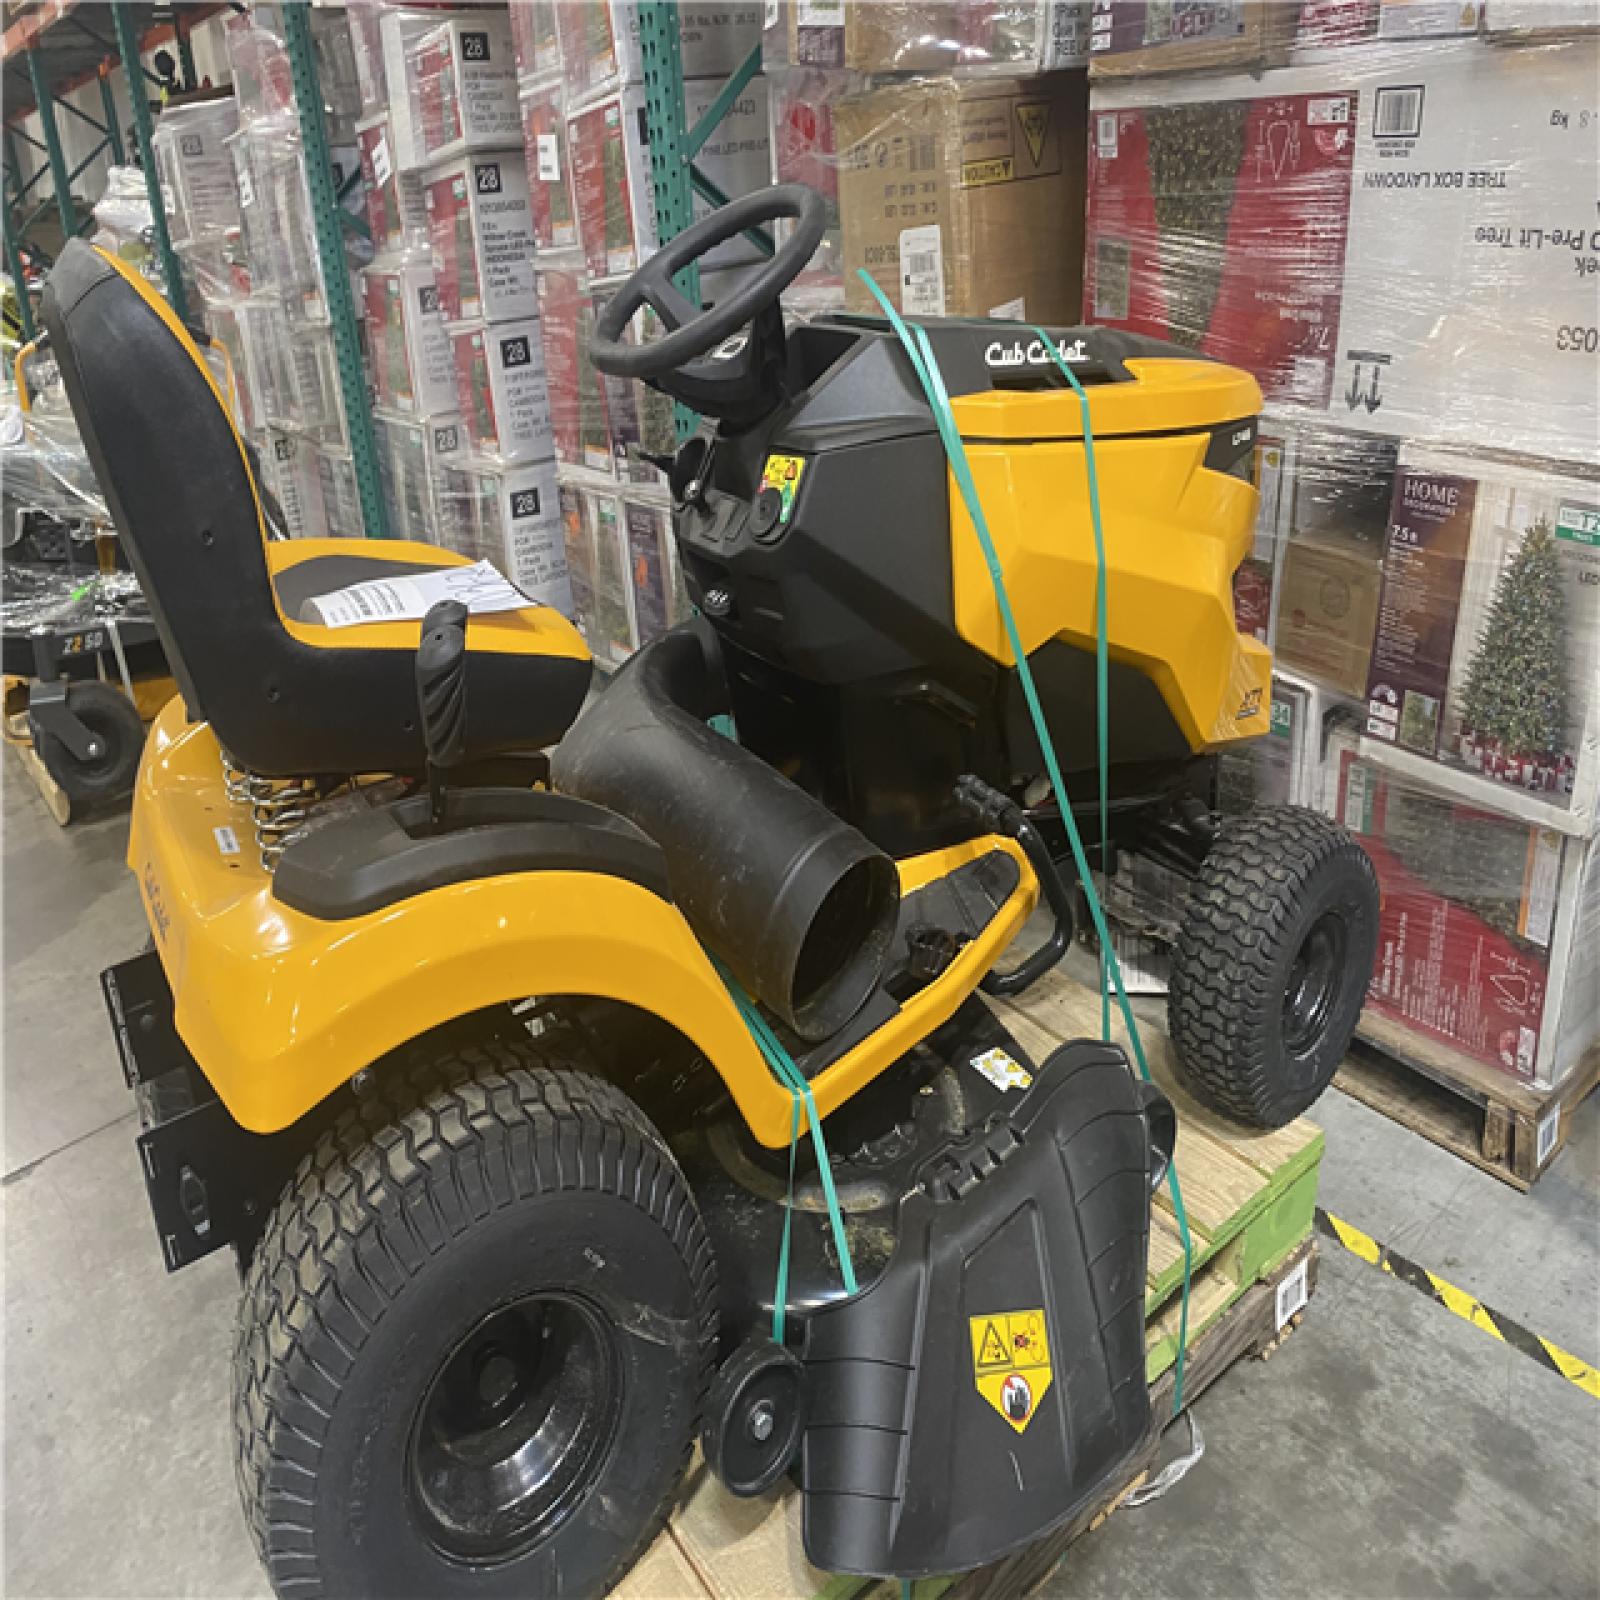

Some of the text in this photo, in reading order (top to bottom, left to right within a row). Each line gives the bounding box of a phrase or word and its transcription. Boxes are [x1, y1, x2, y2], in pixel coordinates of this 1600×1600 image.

[464, 36, 485, 58] 28
[1550, 109, 1569, 129] kg
[478, 167, 499, 191] 28
[1363, 172, 1507, 188] TREE BOX LAYDOWN
[1474, 226, 1514, 248] Tree
[1519, 228, 1585, 251] Pre-Lit
[506, 341, 527, 364] 28
[984, 340, 1026, 366] Cub
[436, 428, 456, 449] 28
[1404, 479, 1459, 506] HOME
[516, 494, 536, 514] 28
